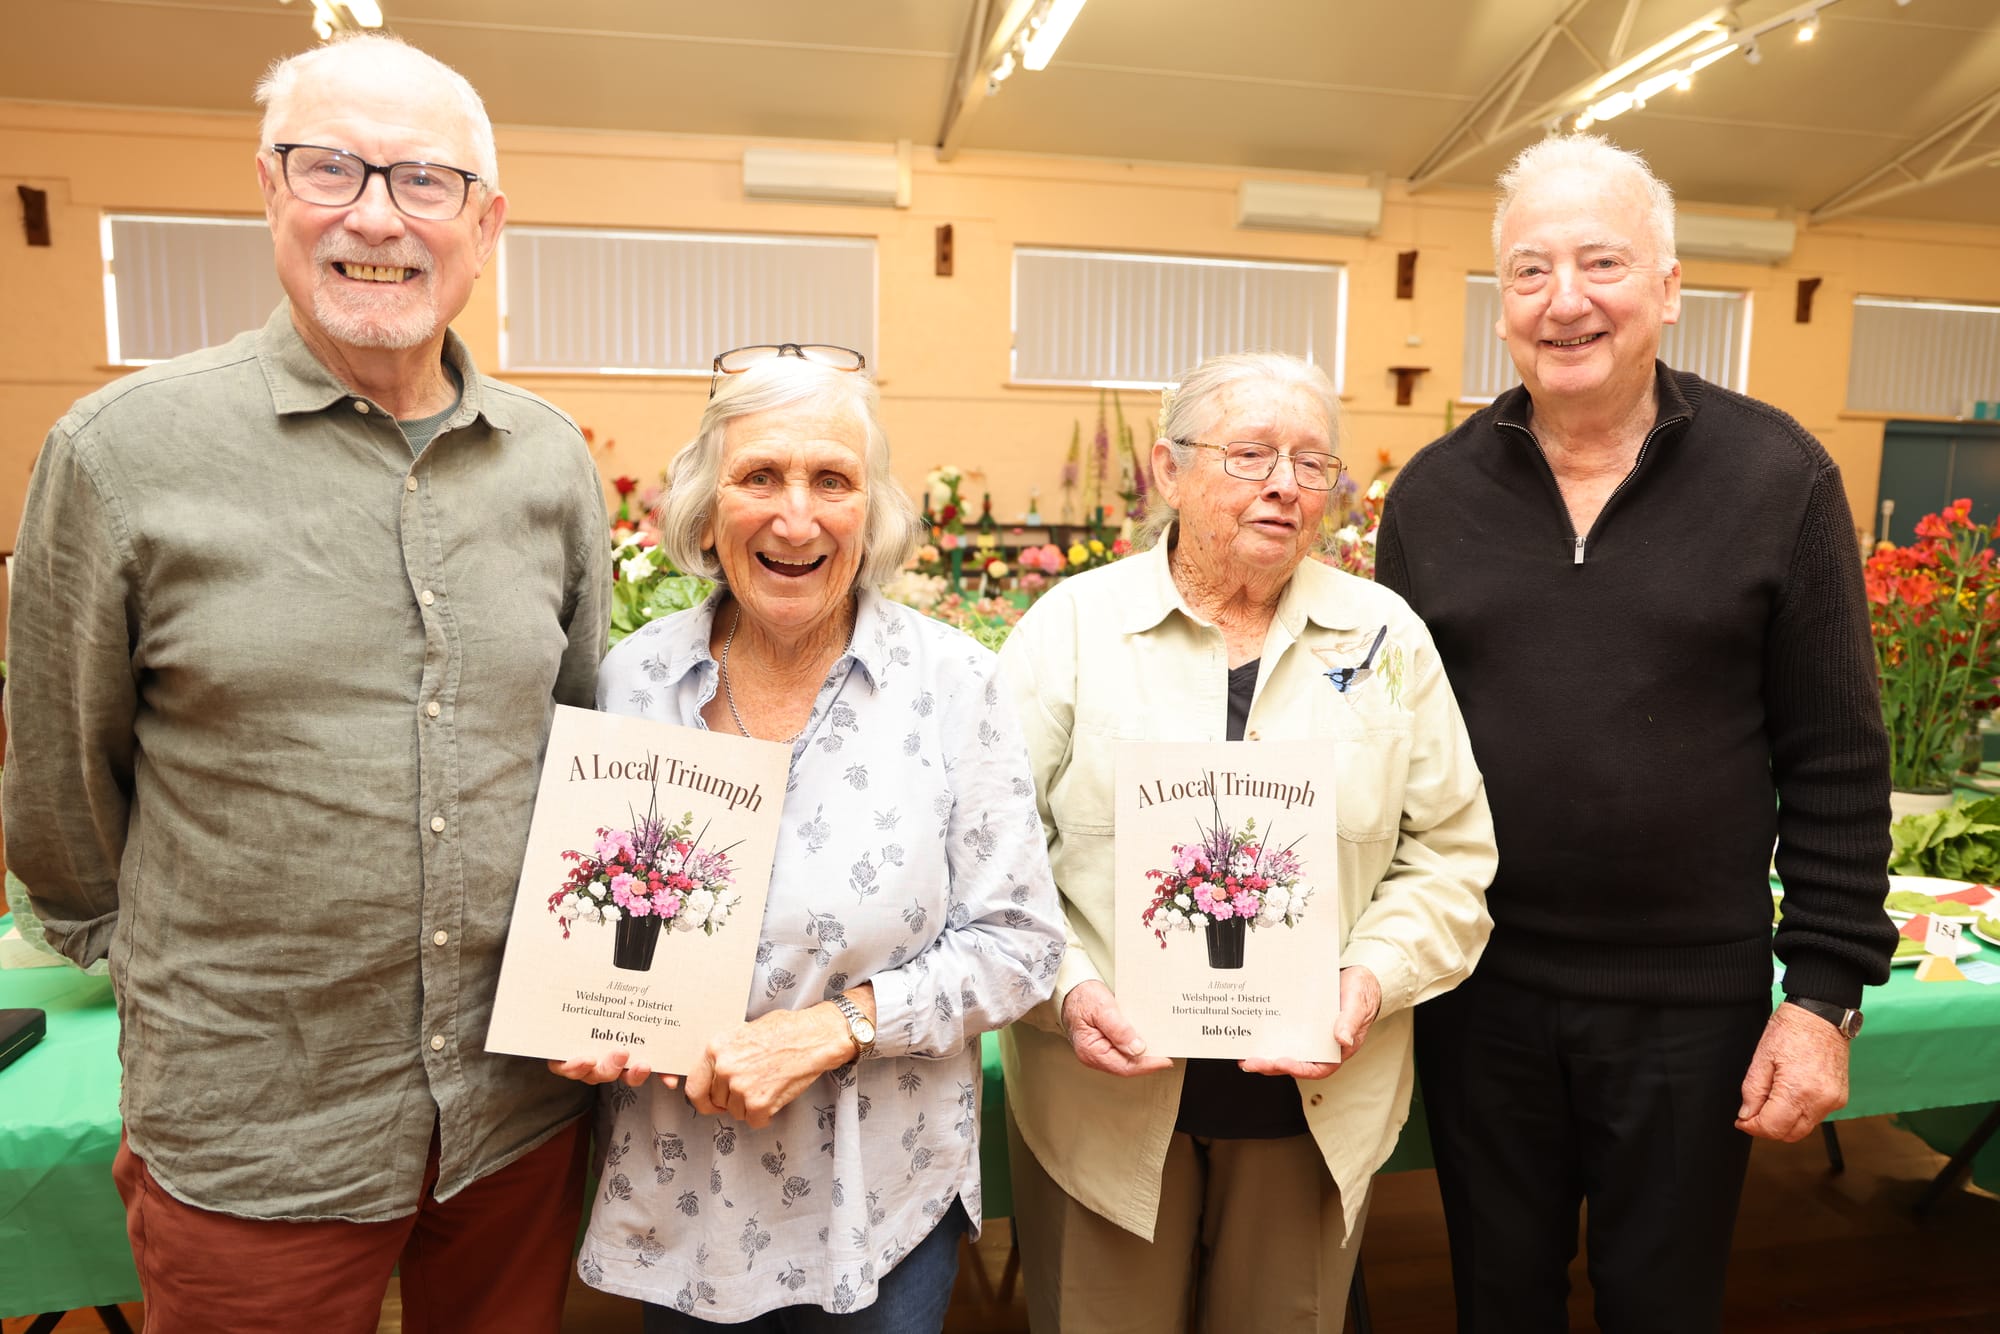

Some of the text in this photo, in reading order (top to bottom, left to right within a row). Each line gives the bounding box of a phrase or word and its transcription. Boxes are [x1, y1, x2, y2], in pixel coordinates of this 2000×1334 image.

[569, 754, 763, 813] A Local Triumph
[1138, 771, 1316, 809] A Local Triumph
[1935, 921, 1956, 940] 154
[606, 981, 649, 995] A History of
[1207, 981, 1246, 990] A History of
[576, 990, 626, 1006] Welshpool
[637, 998, 673, 1012] District
[1182, 992, 1228, 1004] Welshpool
[1237, 993, 1271, 1003] District
[561, 1003, 681, 1027] Horticultural Society inc.
[1172, 1005, 1281, 1018] Horticultural Society inc.
[591, 1028, 645, 1046] Rob Gyles
[1201, 1025, 1252, 1039] Rob Gyles
